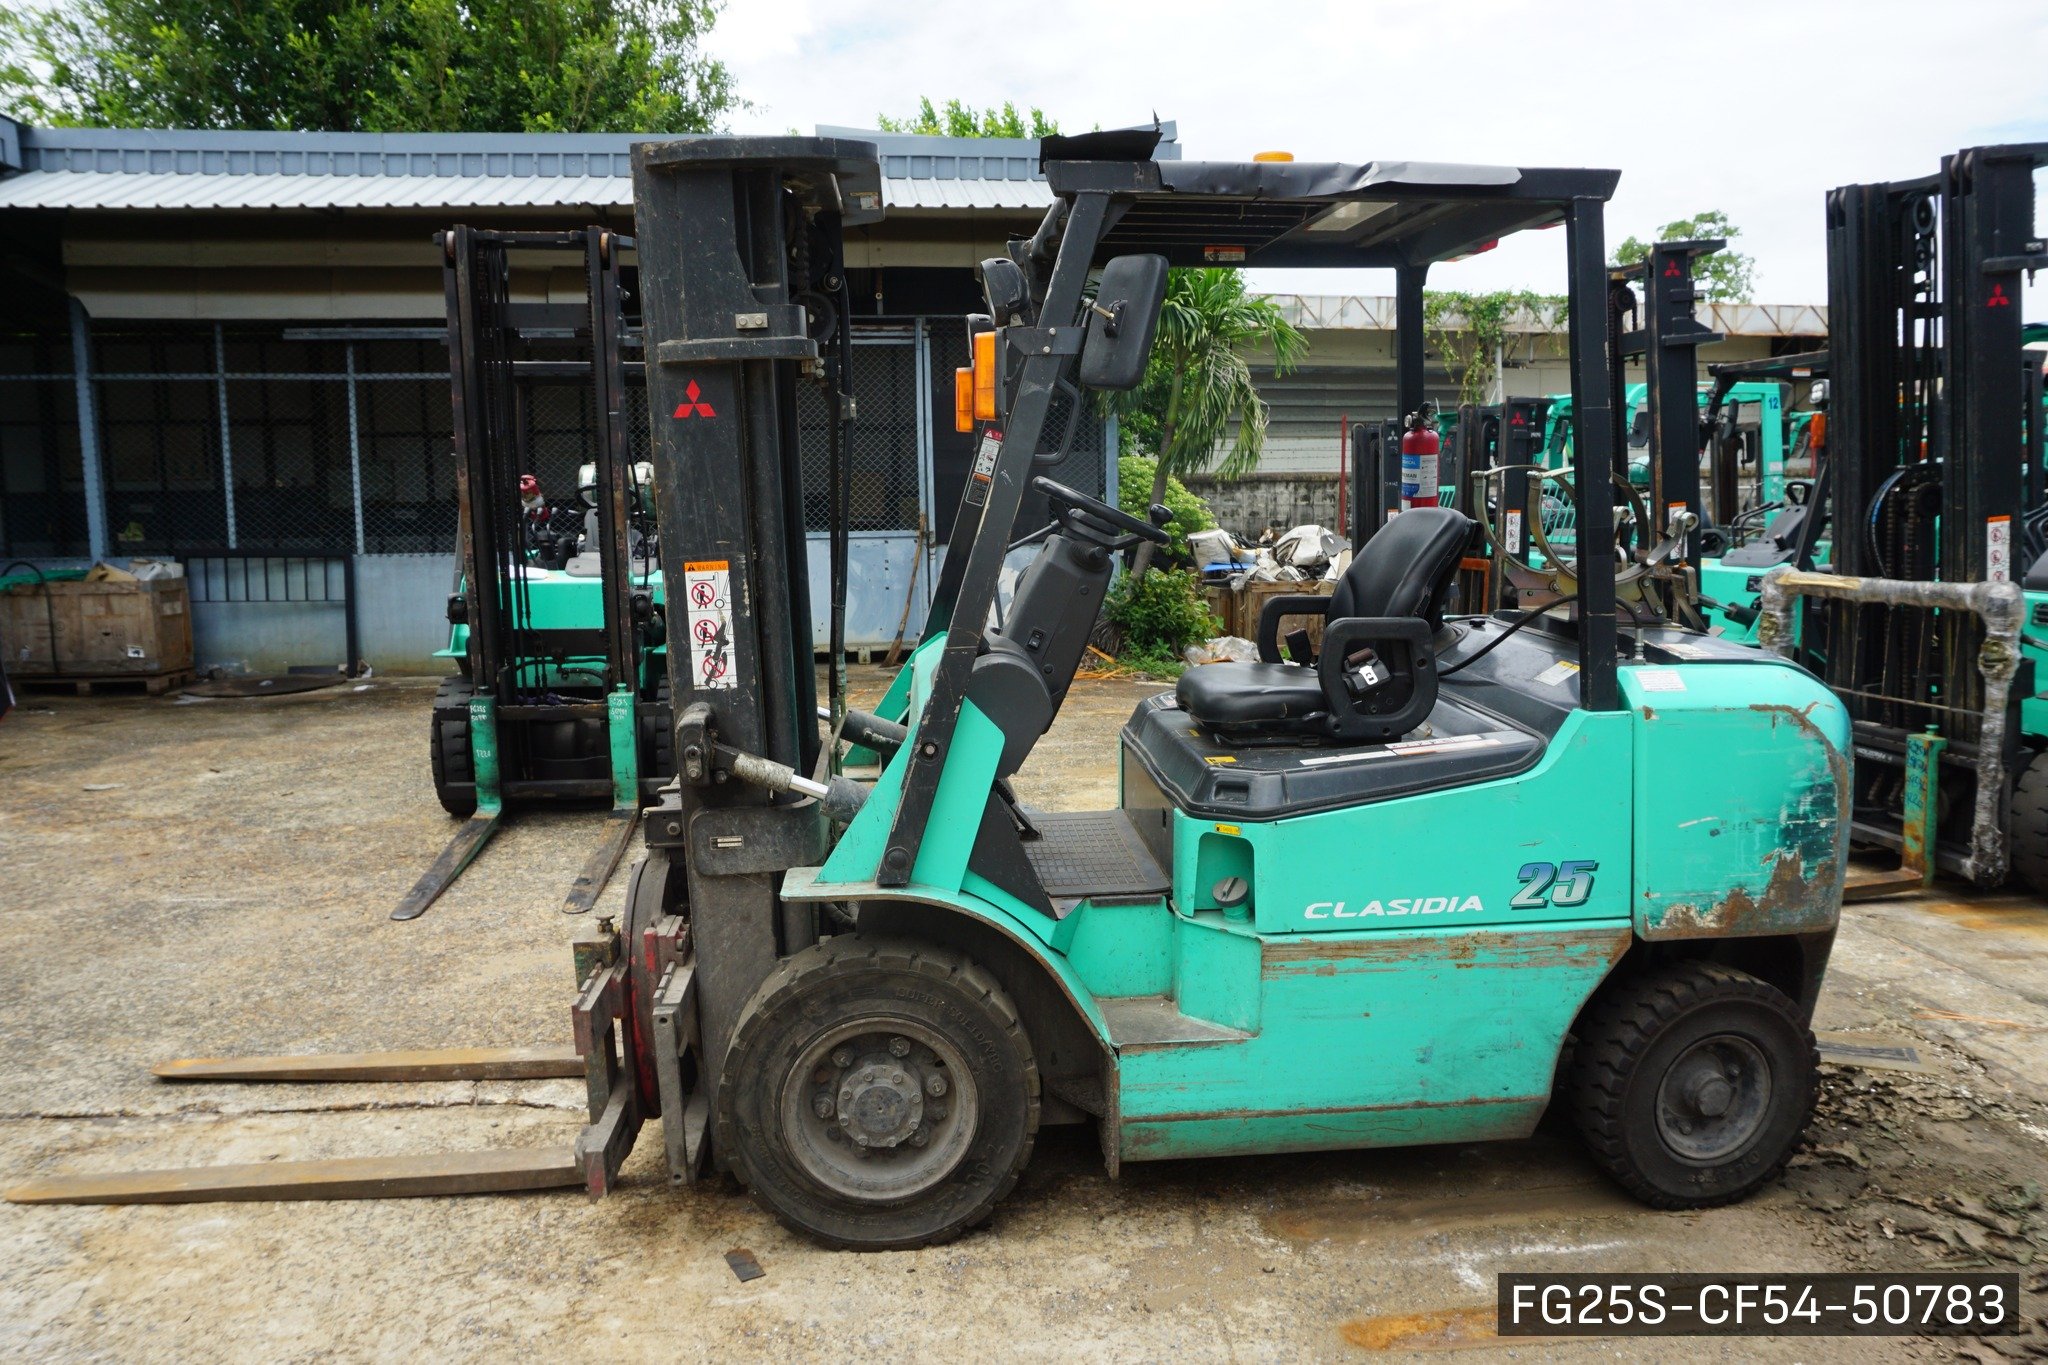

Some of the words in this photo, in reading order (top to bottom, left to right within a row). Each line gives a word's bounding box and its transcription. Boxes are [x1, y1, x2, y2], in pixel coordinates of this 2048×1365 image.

[1769, 397, 1779, 409] 12
[697, 563, 727, 571] WARNING
[1509, 860, 1600, 910] 25
[1304, 895, 1484, 919] CLASIDIA
